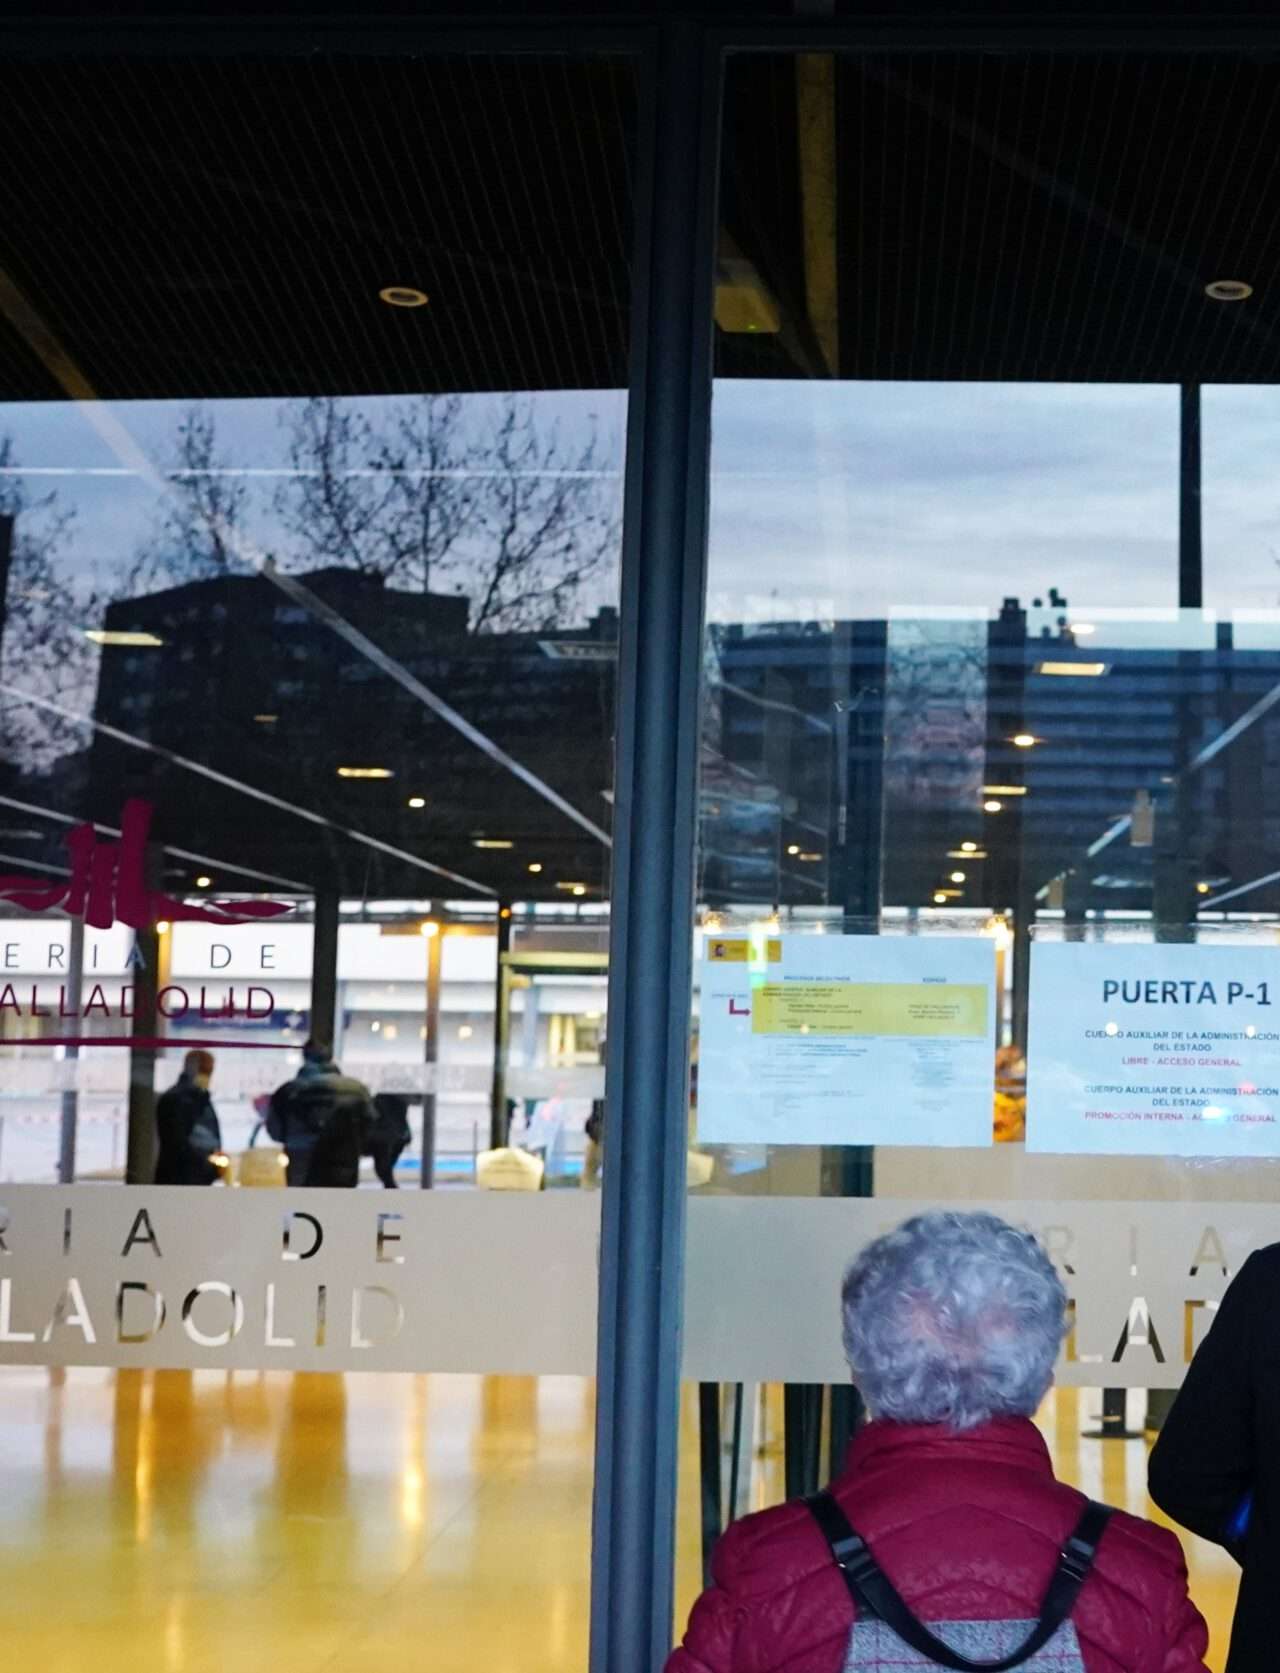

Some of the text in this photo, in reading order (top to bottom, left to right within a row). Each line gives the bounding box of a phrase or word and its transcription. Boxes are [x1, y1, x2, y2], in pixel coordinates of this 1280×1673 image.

[209, 943, 277, 969] DE
[1102, 979, 1272, 1006] PUERTA P-1
[1084, 1030, 1124, 1039] CUEO
[1126, 1030, 1169, 1039] AUXILIAR
[1171, 1031, 1184, 1040] DE
[1186, 1031, 1198, 1040] LA
[1153, 1043, 1212, 1052] DEL ESTADO
[1121, 1056, 1148, 1065] LIBRE
[1156, 1057, 1195, 1066] ACCESO
[1197, 1058, 1241, 1067] GENERAL
[1084, 1085, 1123, 1094] CUERPO
[1125, 1086, 1168, 1095] AUXILIAR
[1170, 1086, 1182, 1095] DE
[1185, 1087, 1197, 1095] LA
[1152, 1098, 1210, 1107] DEL ESTADO
[1084, 1110, 1142, 1121] PROMOCIÓN
[1143, 1112, 1183, 1121] INTERNA
[1232, 1114, 1276, 1123] GENERAL
[281, 1211, 406, 1263] DE
[0, 1277, 405, 1348] LADOLID
